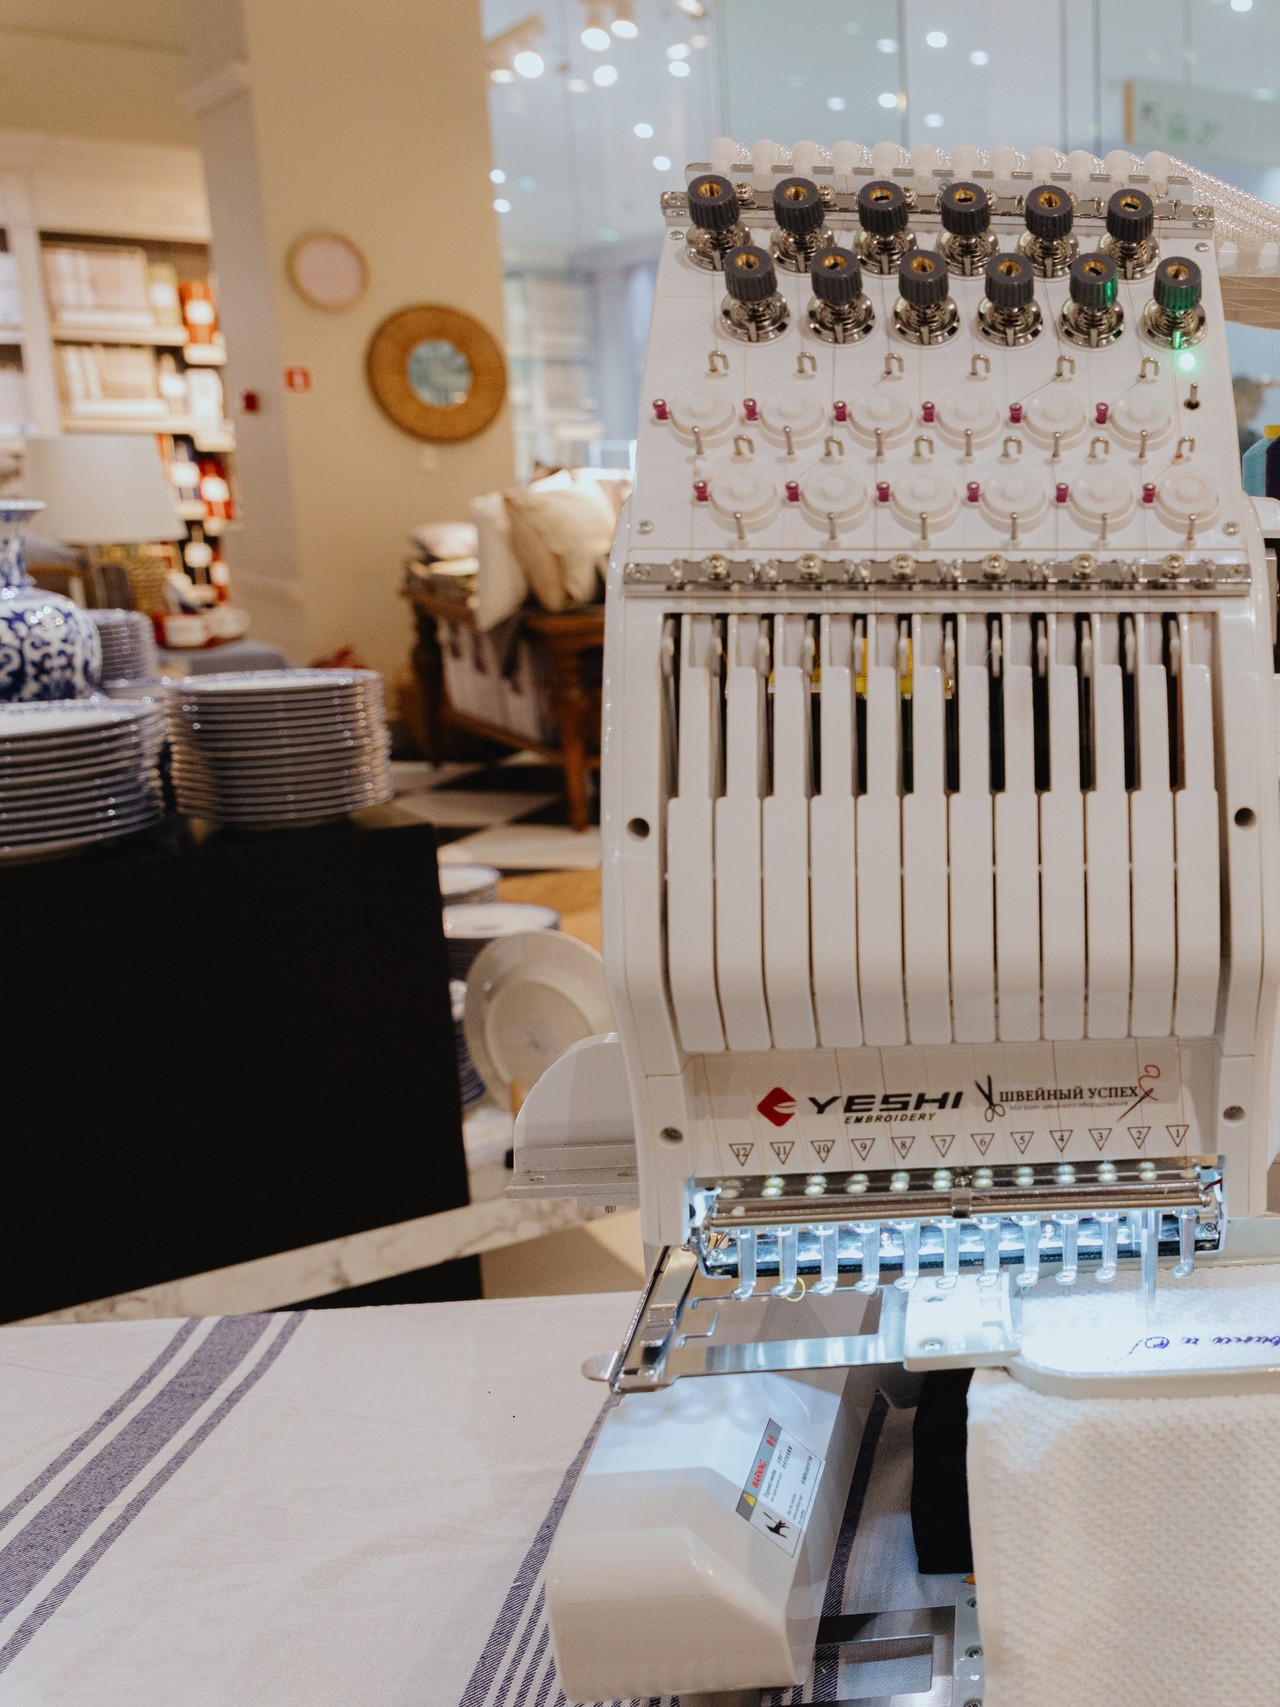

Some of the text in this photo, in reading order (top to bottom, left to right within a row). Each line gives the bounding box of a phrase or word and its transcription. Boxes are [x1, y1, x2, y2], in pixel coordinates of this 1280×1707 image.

[808, 1092, 964, 1114] YESHI
[1000, 1086, 1139, 1102] ШВЕЙНЫЙ УСПЕХ
[844, 1112, 936, 1124] EMBROIDERY
[751, 1459, 767, 1488] WARNING
